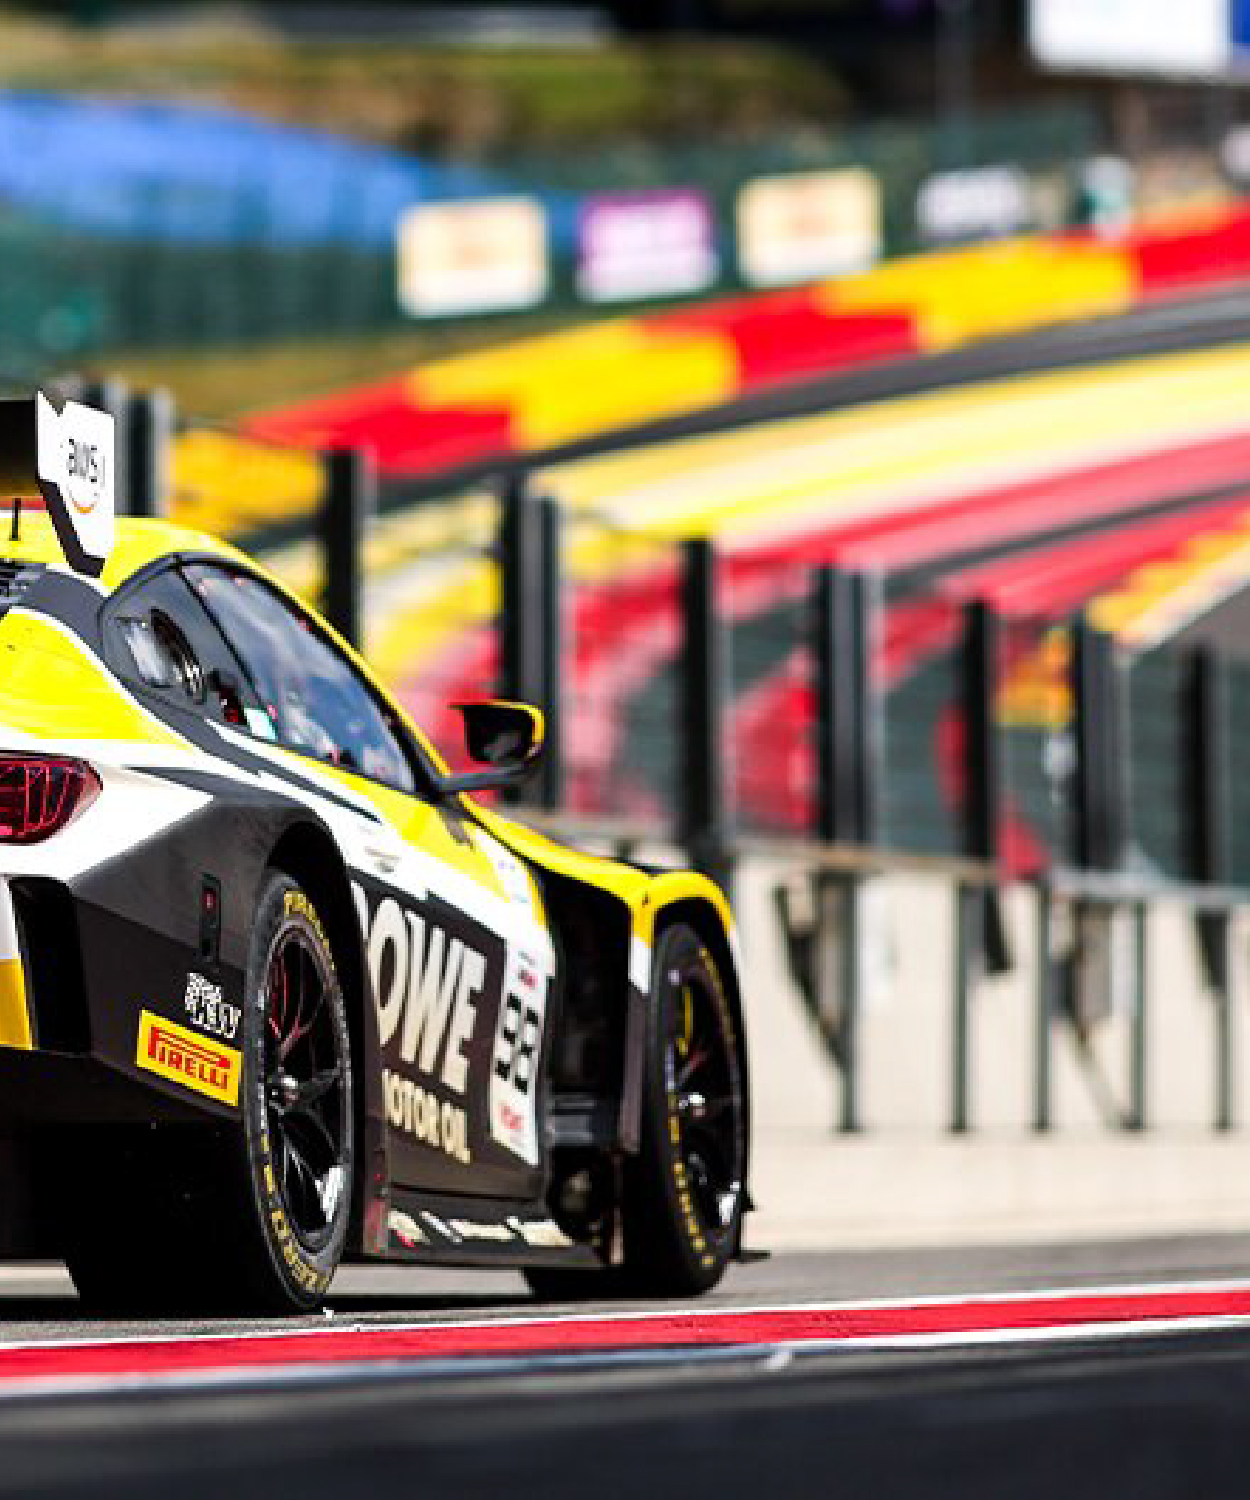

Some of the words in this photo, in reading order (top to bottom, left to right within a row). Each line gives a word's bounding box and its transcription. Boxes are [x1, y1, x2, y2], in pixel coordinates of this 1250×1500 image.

[351, 879, 488, 1093] OWE
[148, 1026, 230, 1090] PIRELLI
[494, 992, 540, 1095] 98
[381, 1068, 440, 1147] OTOR
[441, 1101, 471, 1163] OIL
